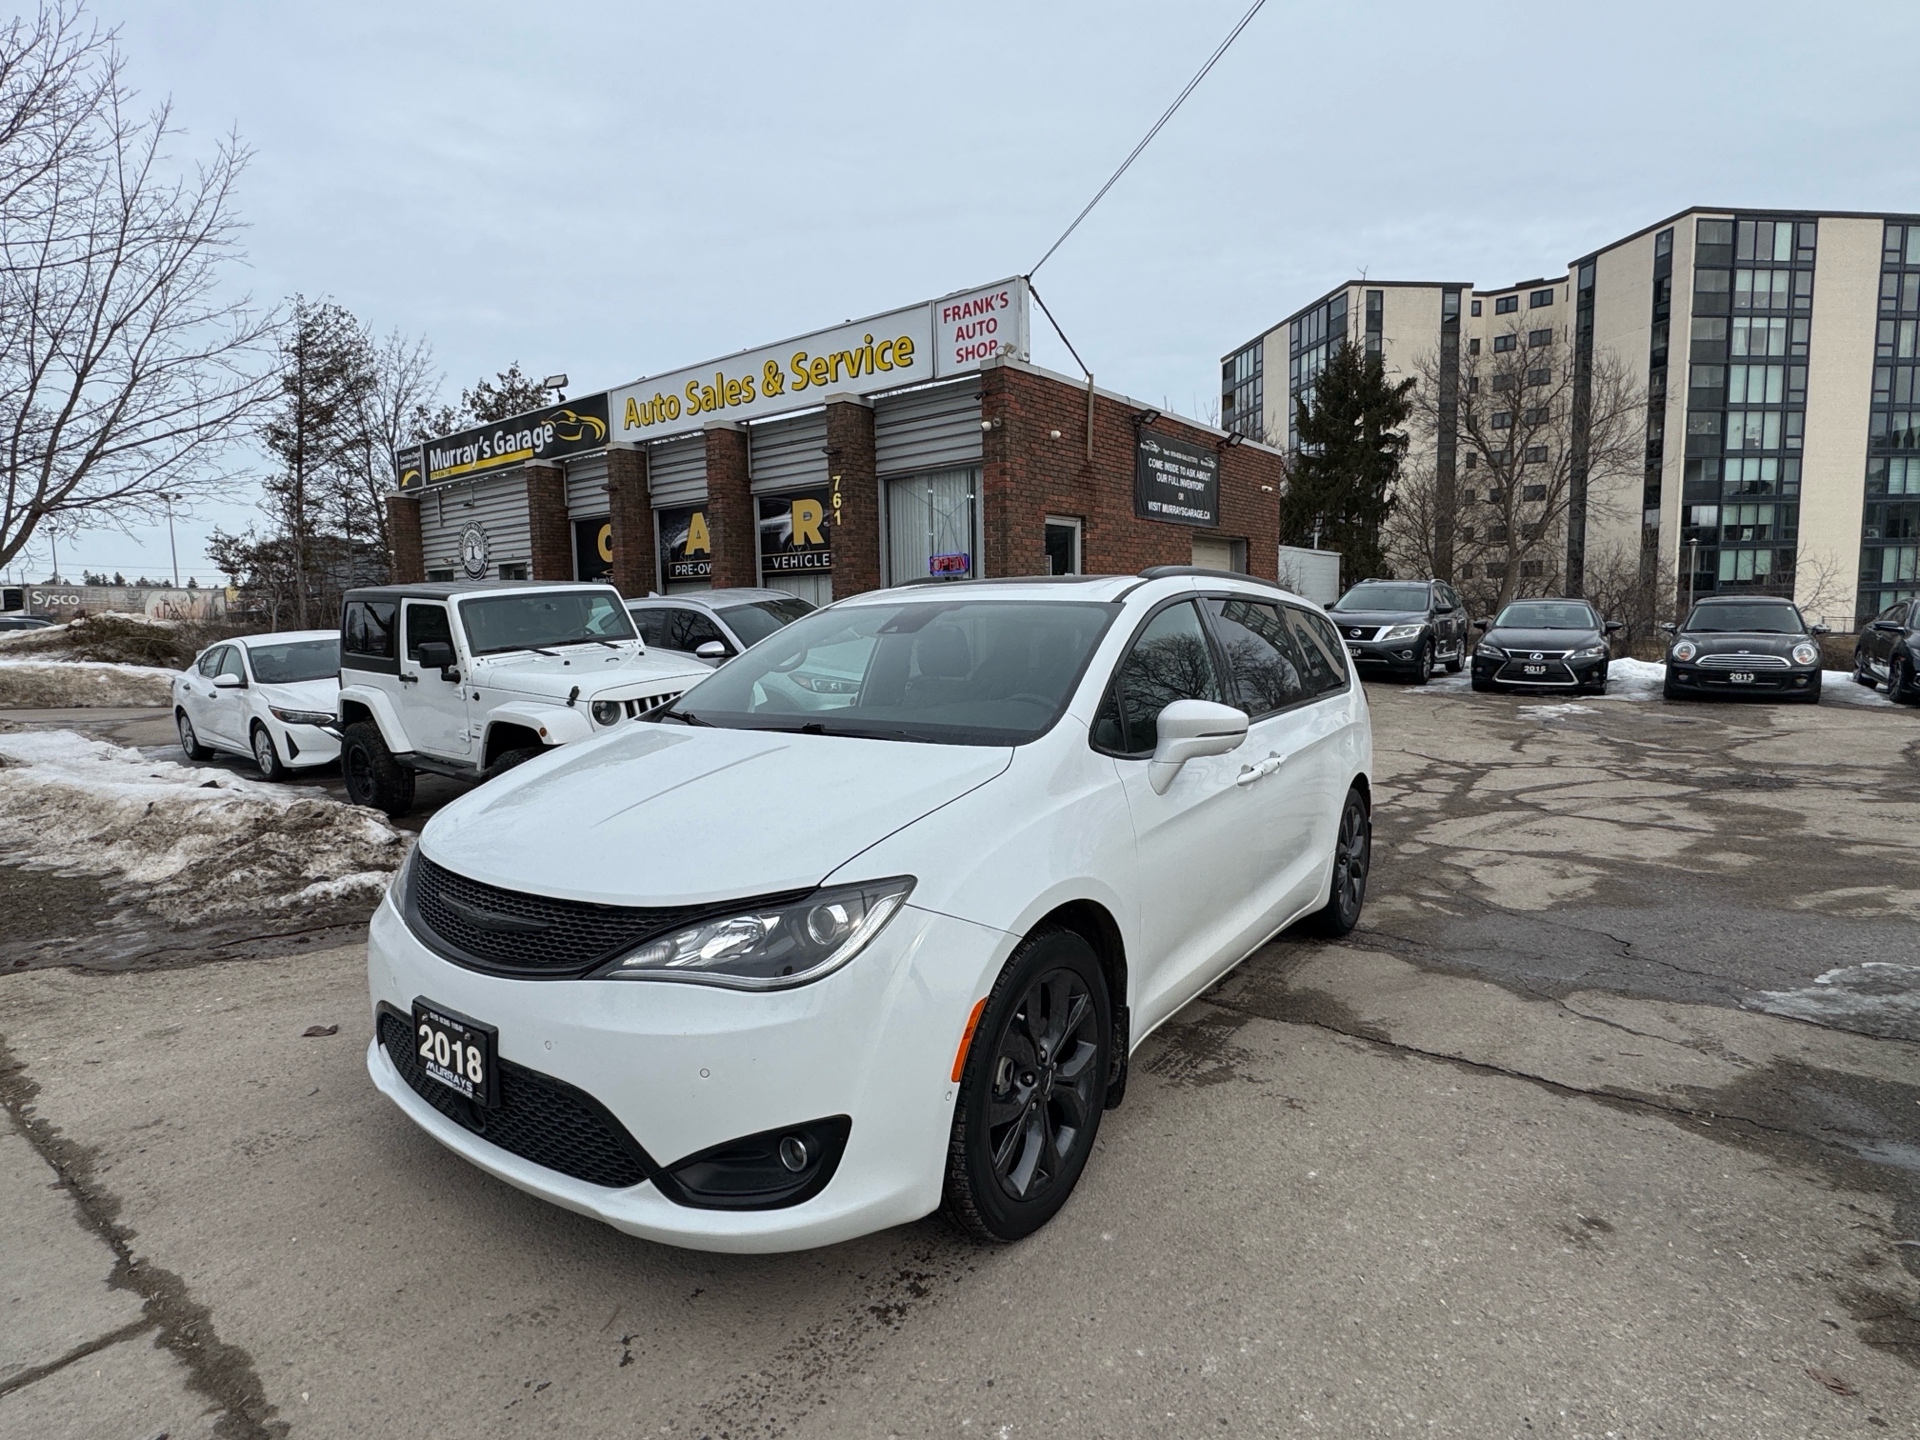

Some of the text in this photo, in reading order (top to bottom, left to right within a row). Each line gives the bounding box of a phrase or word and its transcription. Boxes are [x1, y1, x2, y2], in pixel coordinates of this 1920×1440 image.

[943, 291, 1009, 324] FRANK'S
[955, 317, 998, 342] AUTO
[956, 339, 998, 364] SHOP
[624, 334, 915, 430] Auto Sales & Service
[430, 424, 553, 471] Murray's Garage
[1148, 457, 1211, 482] COME INSIDE TO ASK ABOUT
[1156, 472, 1205, 492] OUR FULL INVENTORY
[1178, 492, 1185, 500] OR
[792, 499, 825, 545] R
[1148, 500, 1210, 519] VISIT MURRAYSGARAGE.CA
[685, 512, 711, 555] A
[932, 556, 966, 571] OPEN
[32, 591, 80, 607] Sysco
[1730, 673, 1755, 681] 2013
[419, 1024, 483, 1083] 2018
[426, 1061, 473, 1091] MURRAYS
